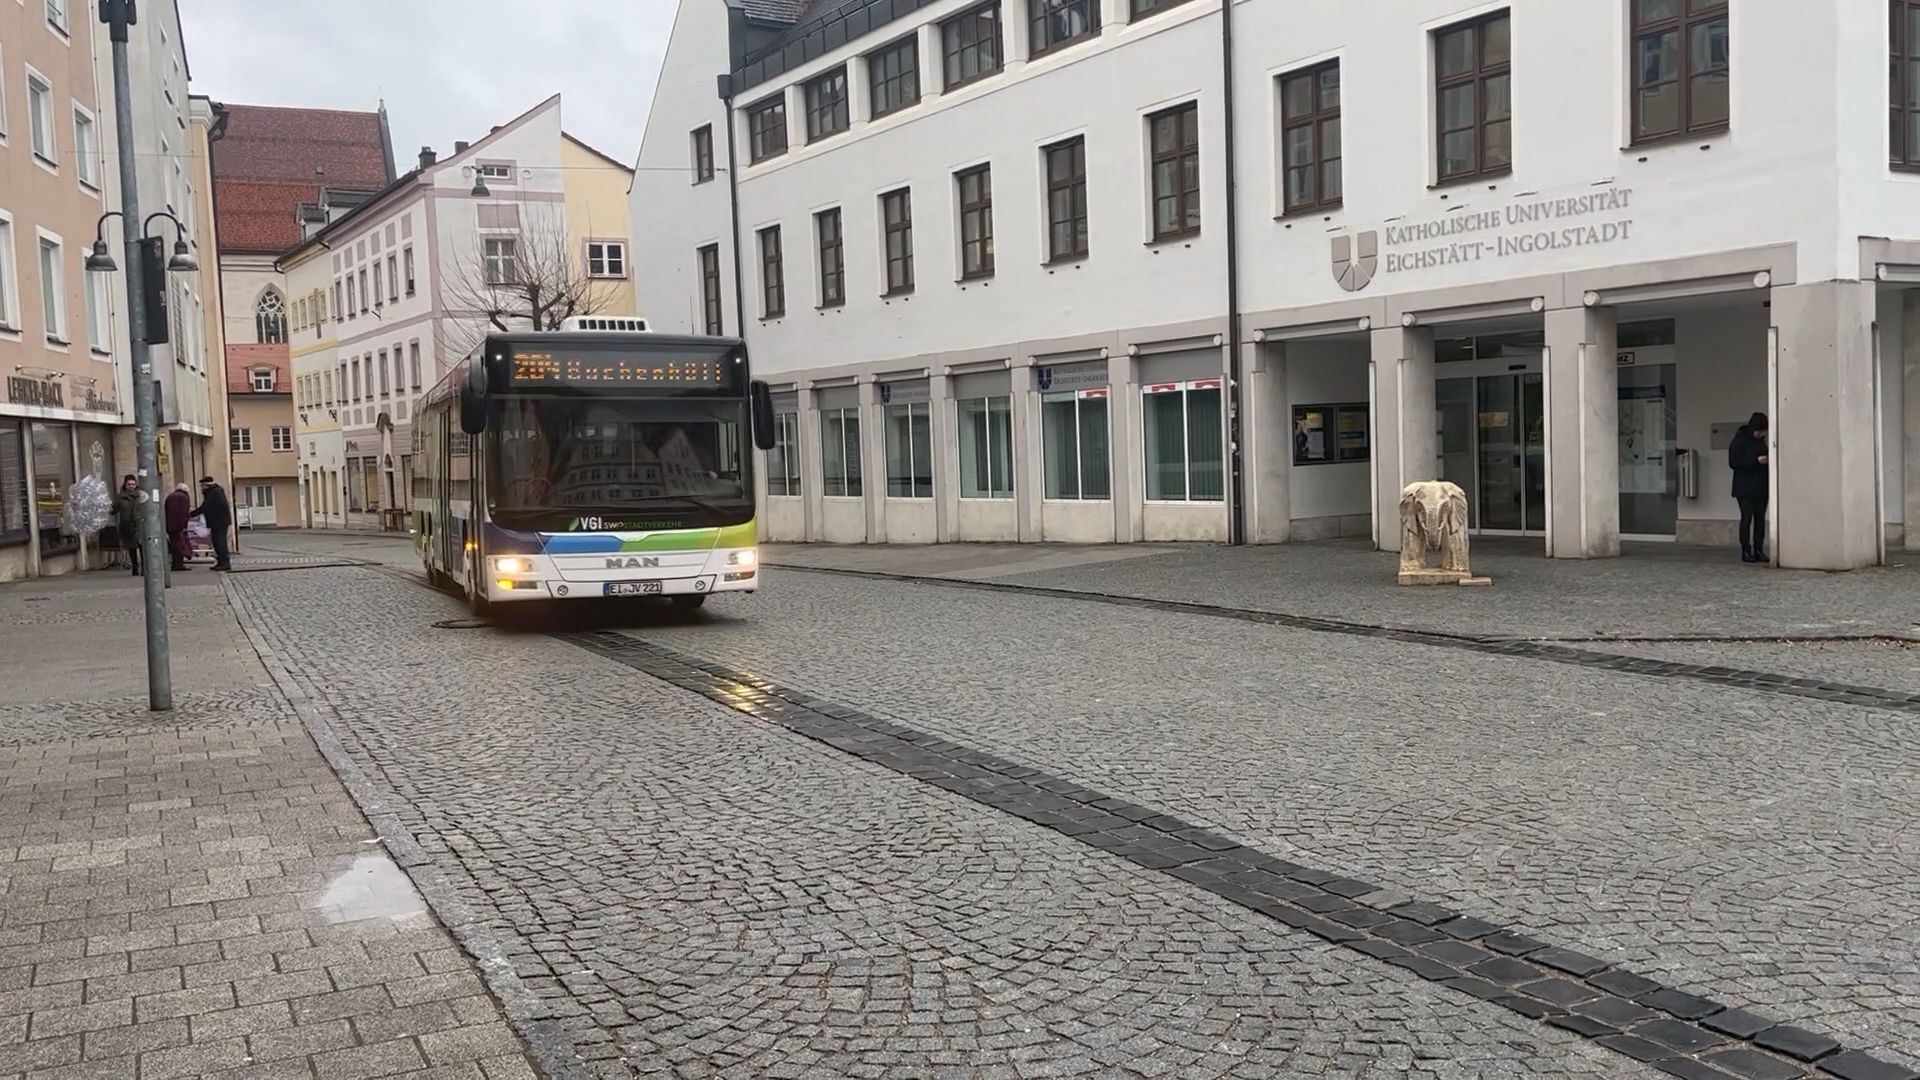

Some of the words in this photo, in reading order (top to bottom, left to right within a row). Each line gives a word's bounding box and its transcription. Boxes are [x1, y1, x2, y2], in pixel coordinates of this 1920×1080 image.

[1386, 210, 1500, 246] KATHOLISCHE
[1506, 188, 1632, 225] UNIVERSITÄT
[1386, 220, 1632, 273] EICHSTÄTT-INGOLSTADT
[580, 517, 602, 530] VGI
[606, 557, 659, 568] MAN
[610, 585, 622, 593] EI
[629, 584, 641, 593] JV
[643, 583, 660, 592] 221
